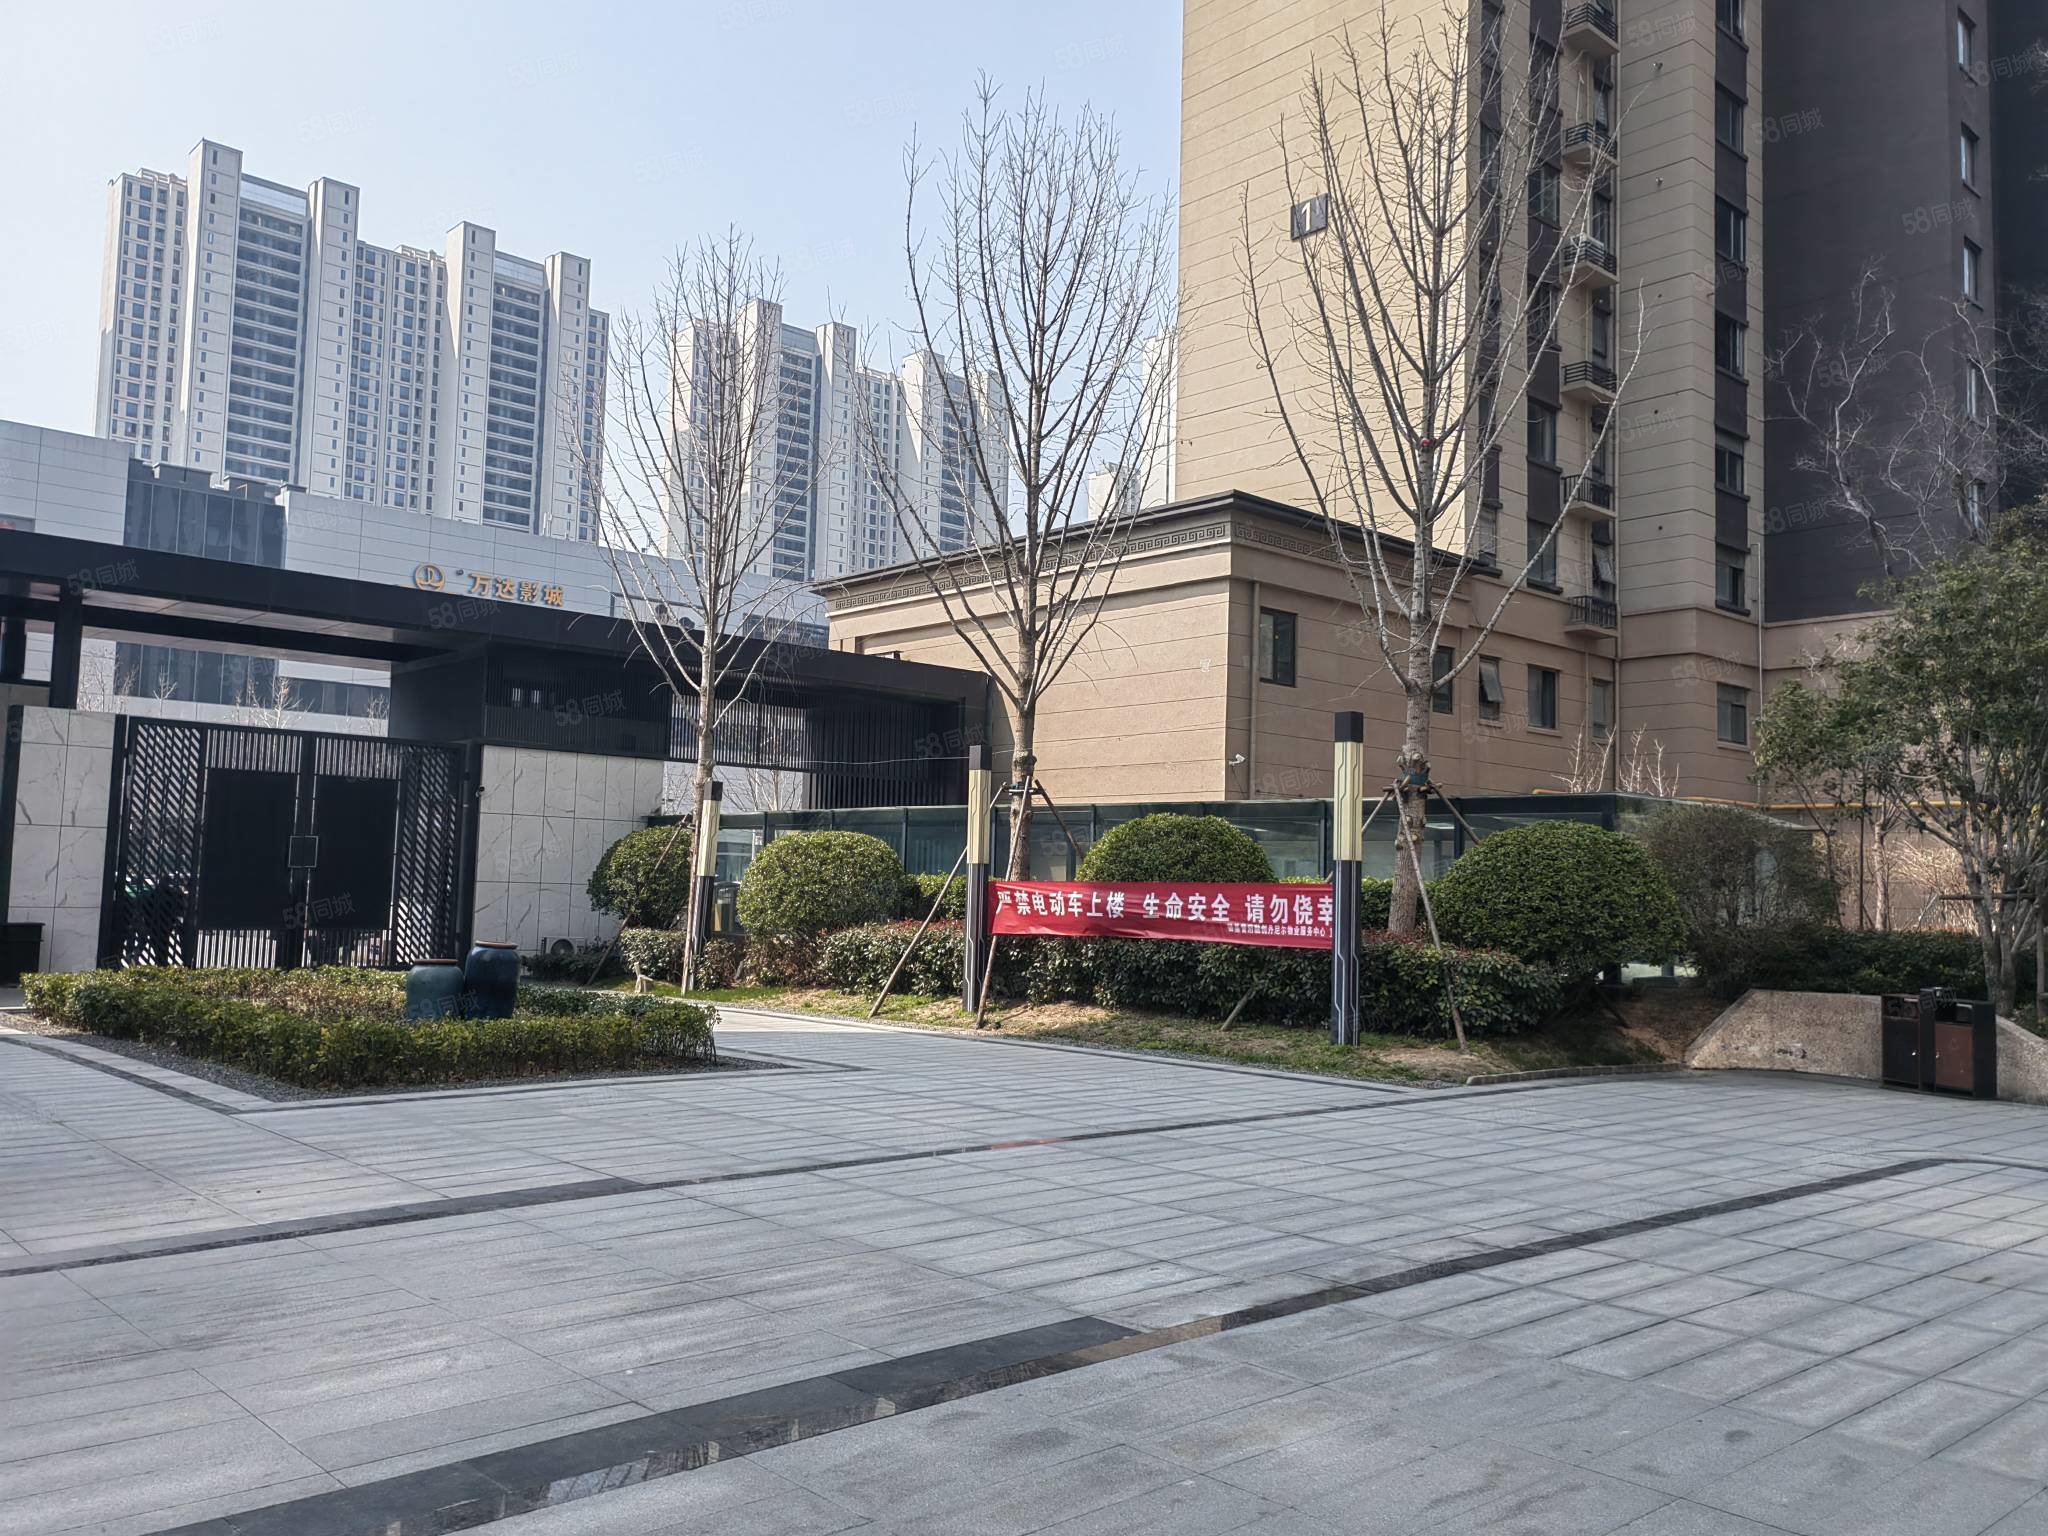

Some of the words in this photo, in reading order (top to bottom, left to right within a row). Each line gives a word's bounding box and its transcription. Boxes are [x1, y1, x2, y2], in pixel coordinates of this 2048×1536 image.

[467, 572, 565, 607] 万达影城
[995, 890, 1125, 918] 严禁电动车上楼
[1143, 891, 1230, 922] 生命安全
[1244, 893, 1334, 925] 请勿侥幸
